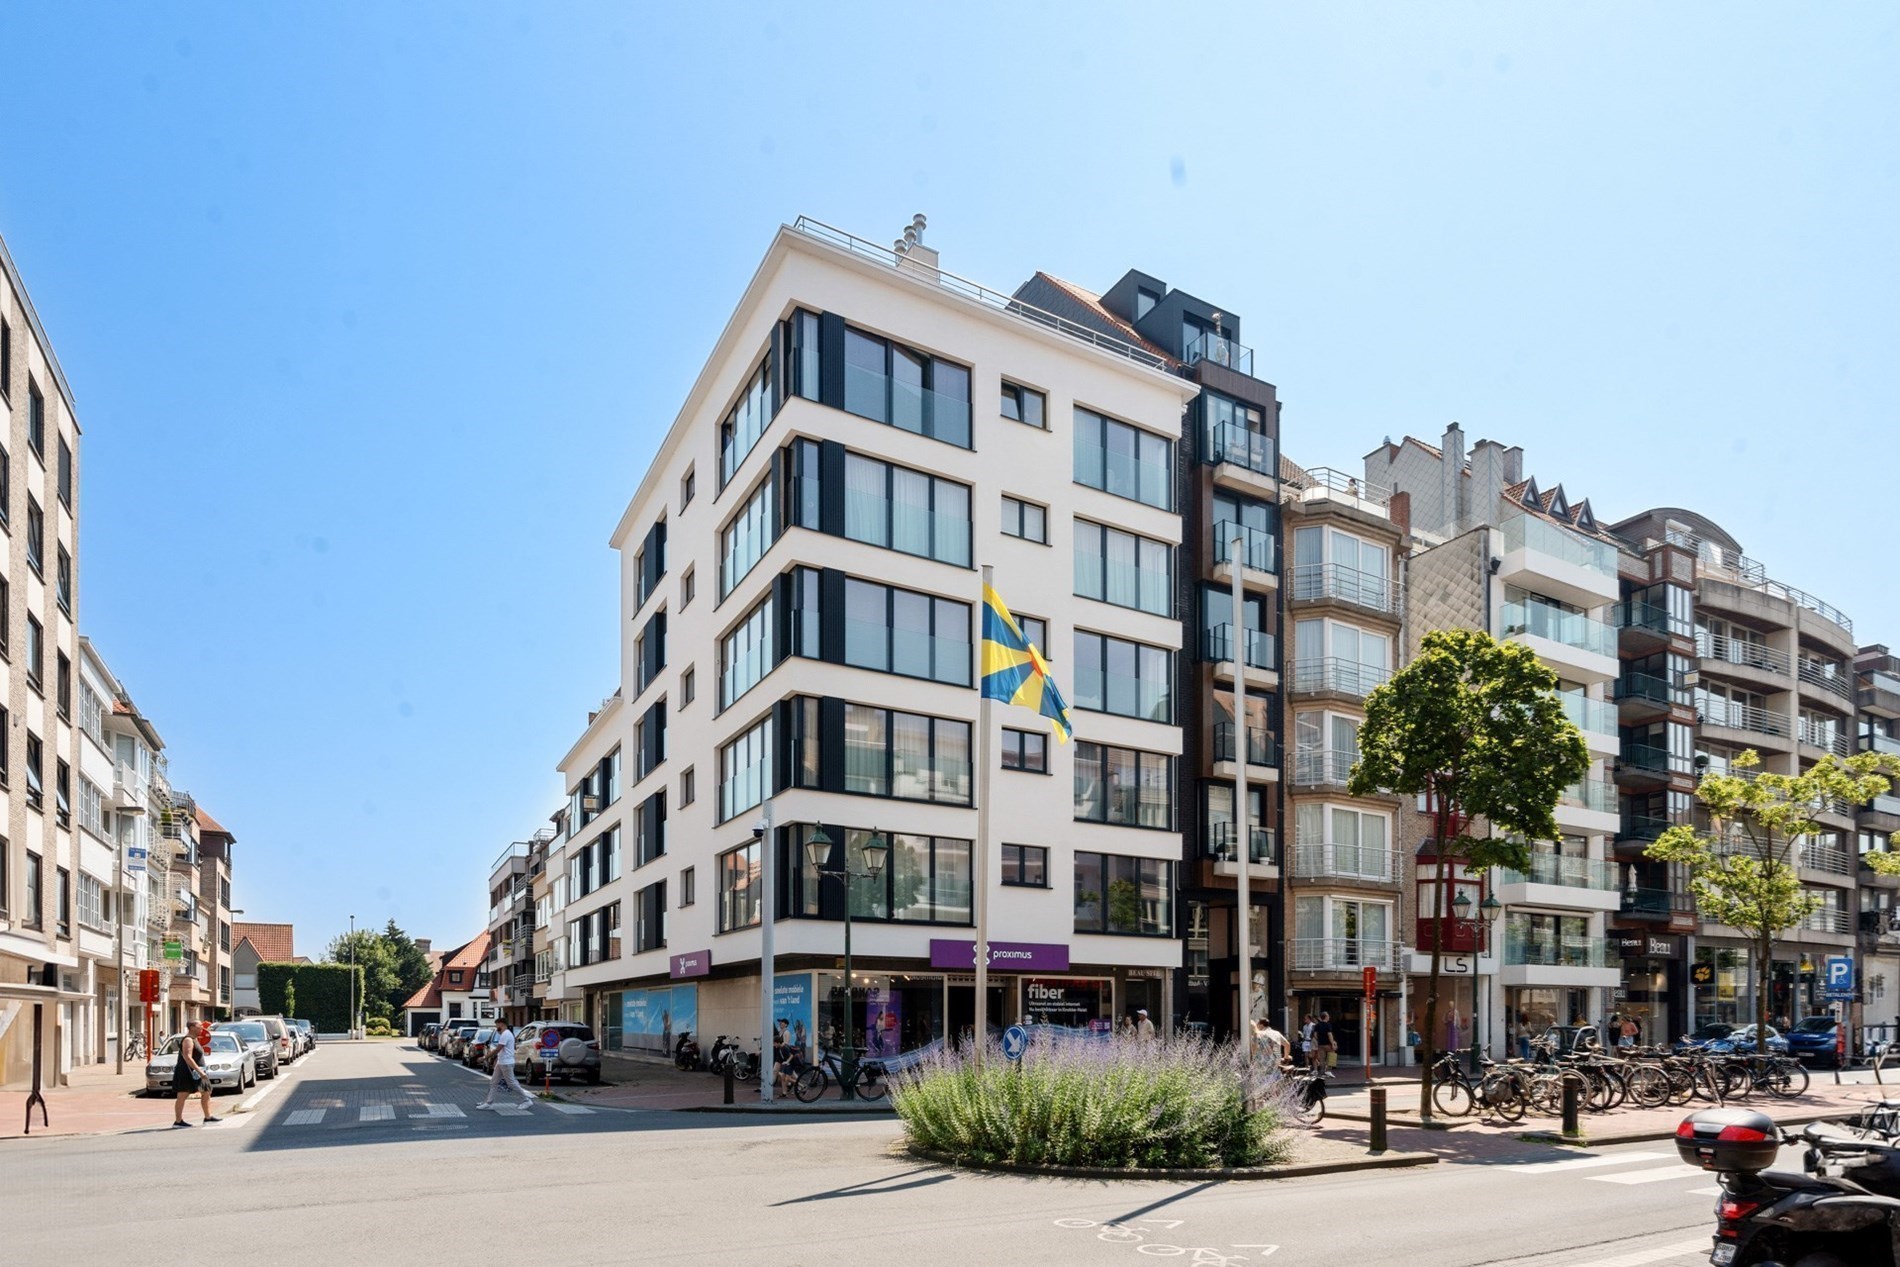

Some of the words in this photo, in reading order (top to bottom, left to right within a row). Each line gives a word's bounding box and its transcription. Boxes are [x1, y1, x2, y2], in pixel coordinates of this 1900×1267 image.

[1649, 938, 1671, 954] Beau
[993, 950, 1032, 960] proximus
[1445, 957, 1468, 973] LS
[1831, 963, 1848, 984] P
[1027, 983, 1065, 999] fiber
